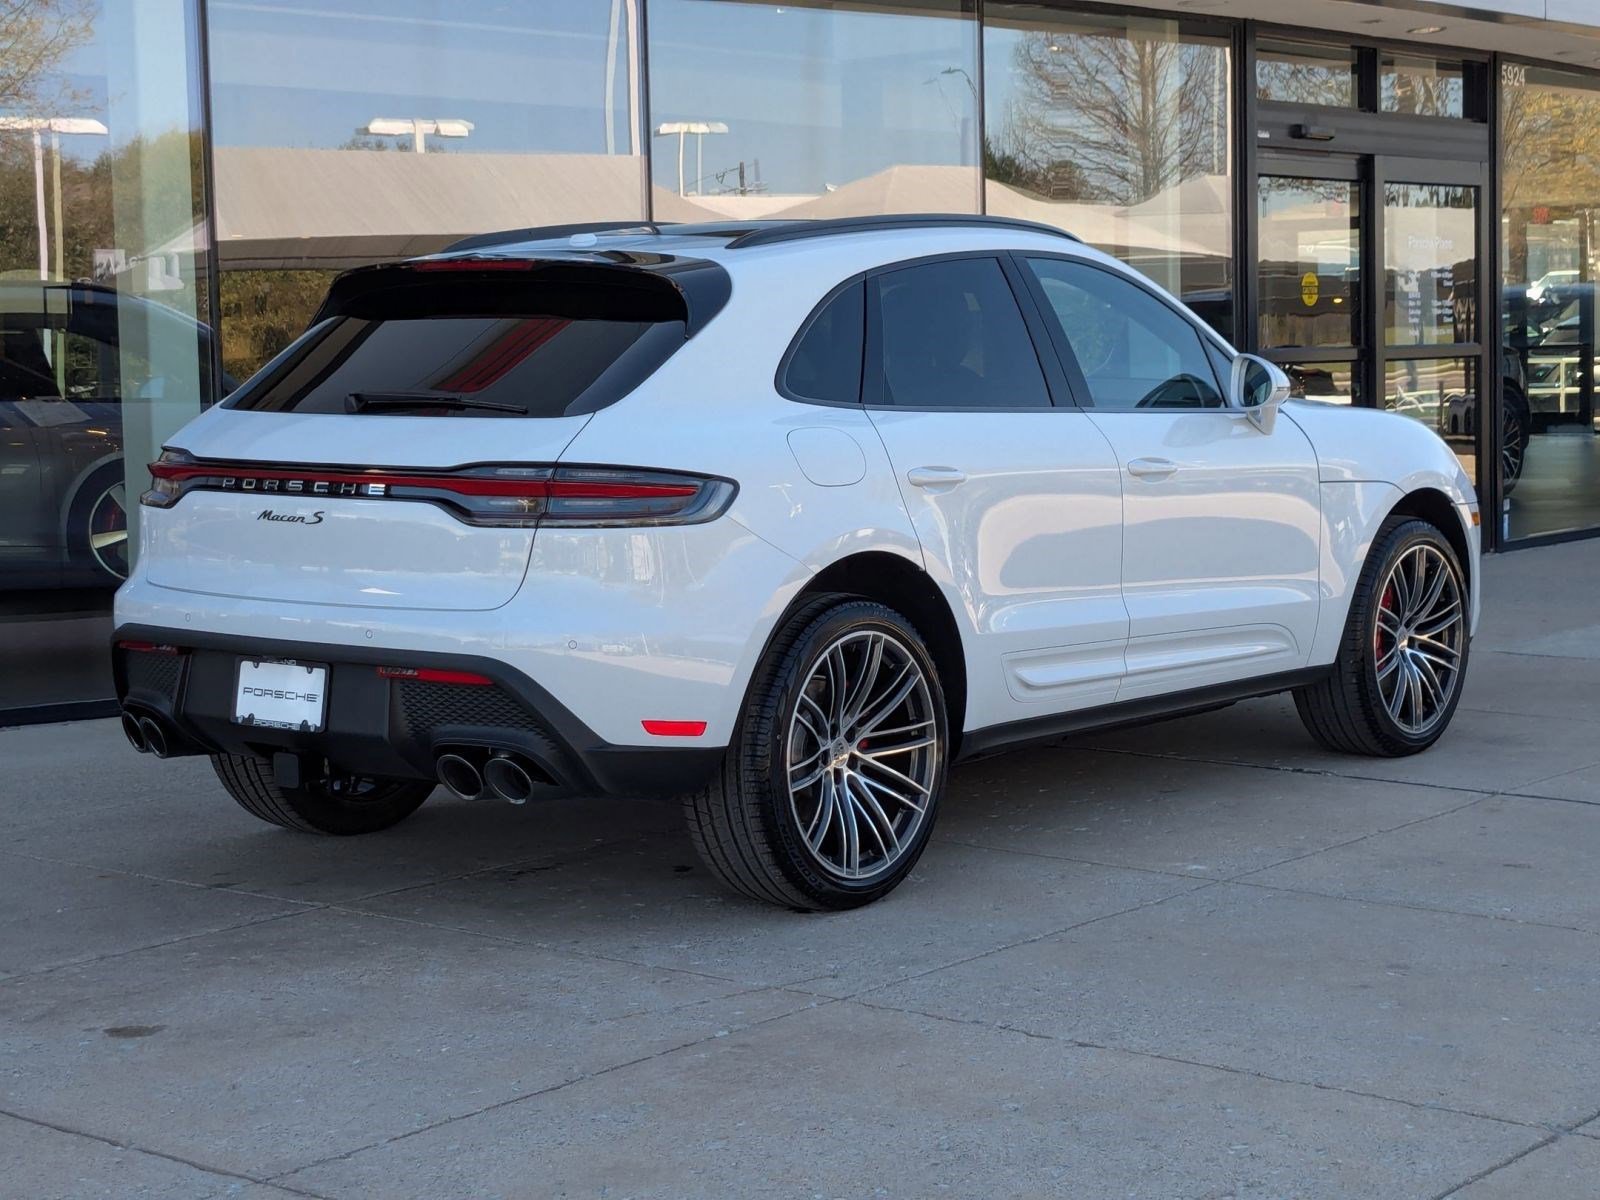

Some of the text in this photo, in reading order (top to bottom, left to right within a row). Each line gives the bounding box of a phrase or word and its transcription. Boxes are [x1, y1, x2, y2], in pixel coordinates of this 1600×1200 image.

[1501, 64, 1525, 87] 5924
[222, 477, 386, 496] PORSCHE
[257, 509, 325, 525] Macan S
[243, 687, 318, 702] PORSCHE
